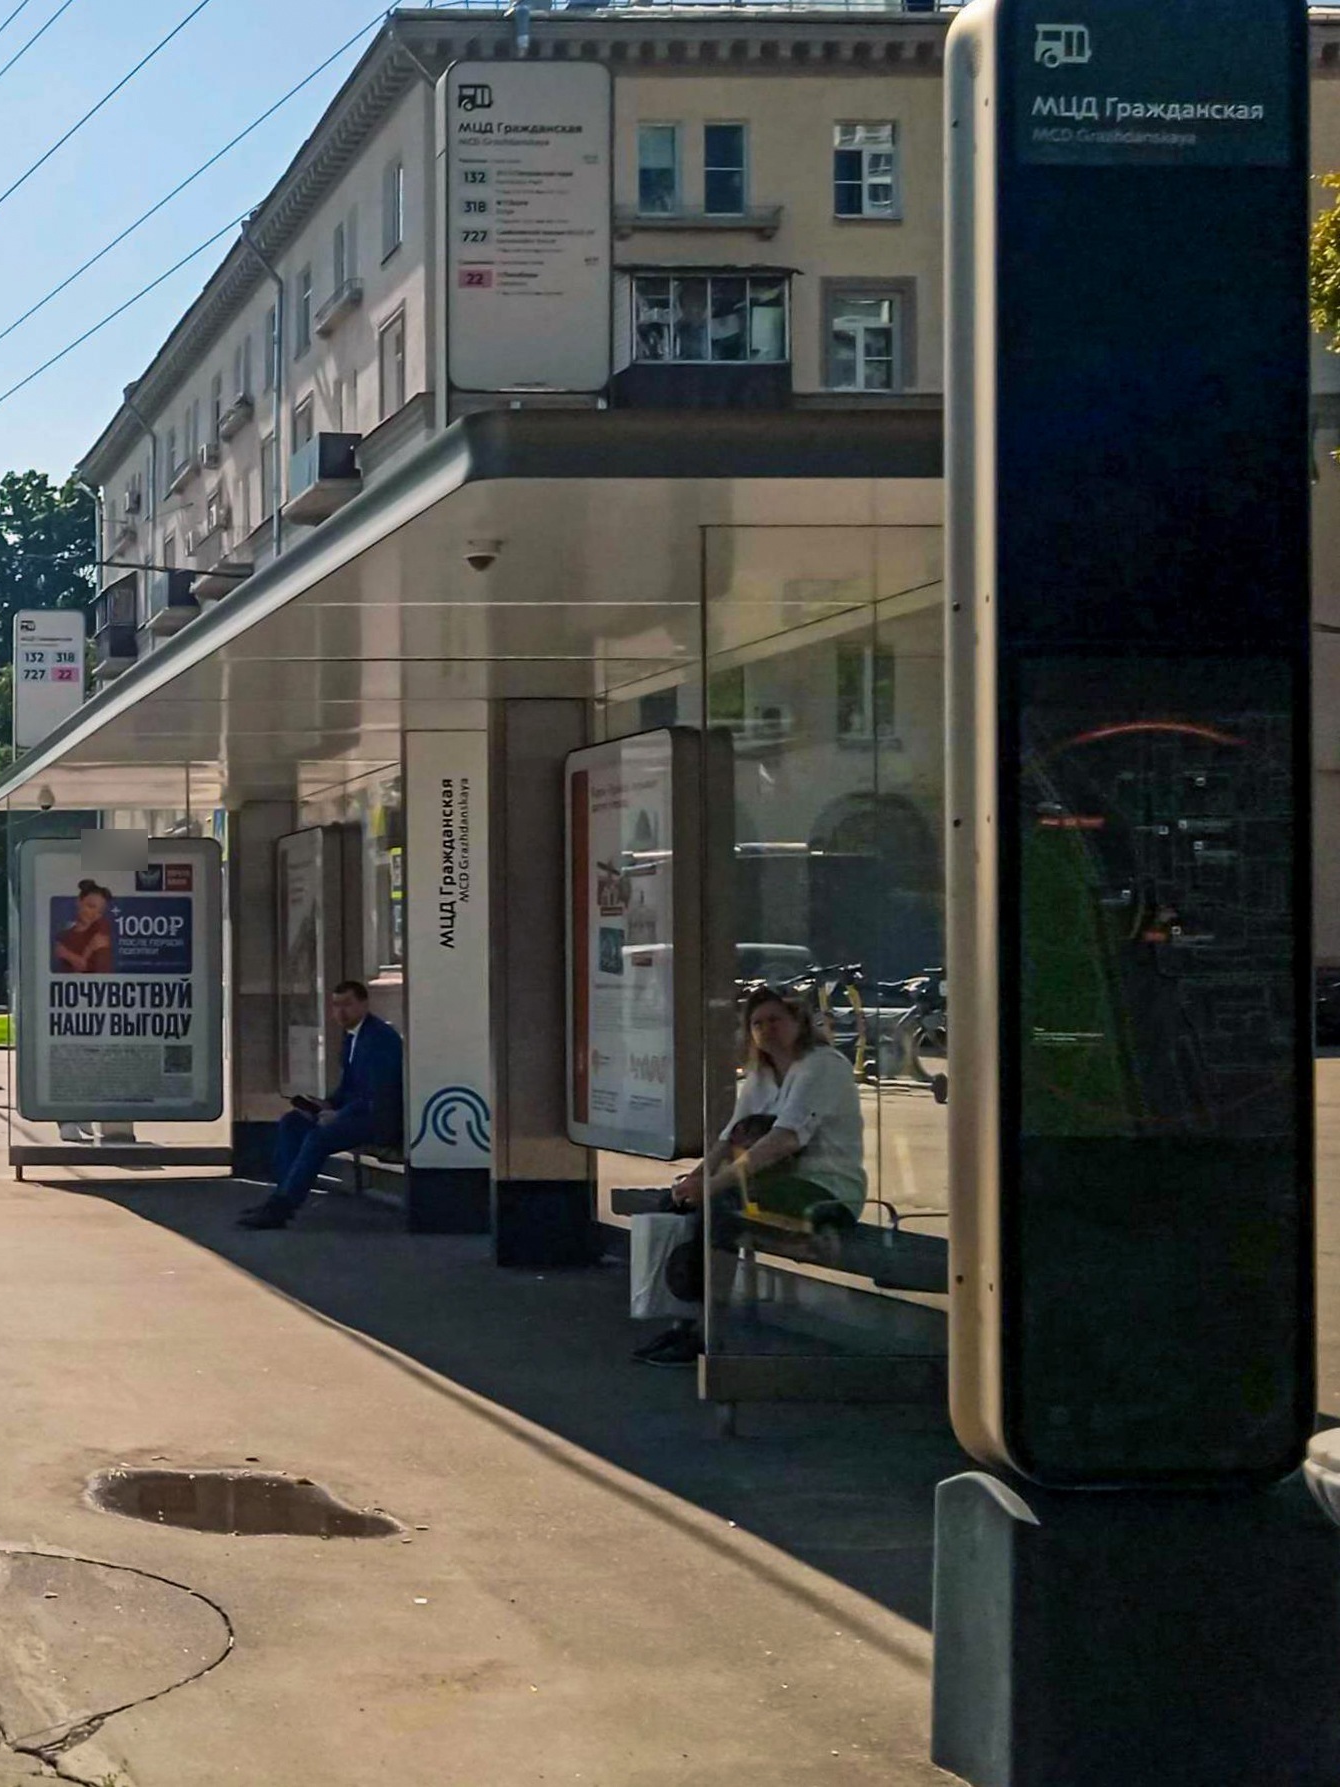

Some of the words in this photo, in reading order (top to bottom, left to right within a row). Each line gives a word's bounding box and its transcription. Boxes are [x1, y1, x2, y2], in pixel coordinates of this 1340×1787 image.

[1031, 95, 1098, 120] МЦД
[1106, 97, 1264, 122] Гражданская
[458, 121, 494, 134] МЦД
[497, 122, 583, 135] Гражданская
[1032, 127, 1073, 143] MCD
[464, 171, 487, 184] 132
[464, 201, 487, 213] 318
[462, 230, 488, 243] 727
[466, 273, 484, 285] 22
[25, 652, 45, 663] 132
[55, 652, 76, 663] 318
[23, 669, 46, 680] 727
[58, 669, 73, 680] 22
[458, 777, 470, 870] Grazhdanskaya
[439, 778, 457, 896] Гражданская
[458, 872, 471, 903] MCD
[439, 901, 457, 949] МЦД
[49, 978, 193, 1009] ПОЧУВСТВУЙ
[49, 1013, 106, 1037] НАШУ
[110, 1013, 192, 1040] ВЫГОДУ
